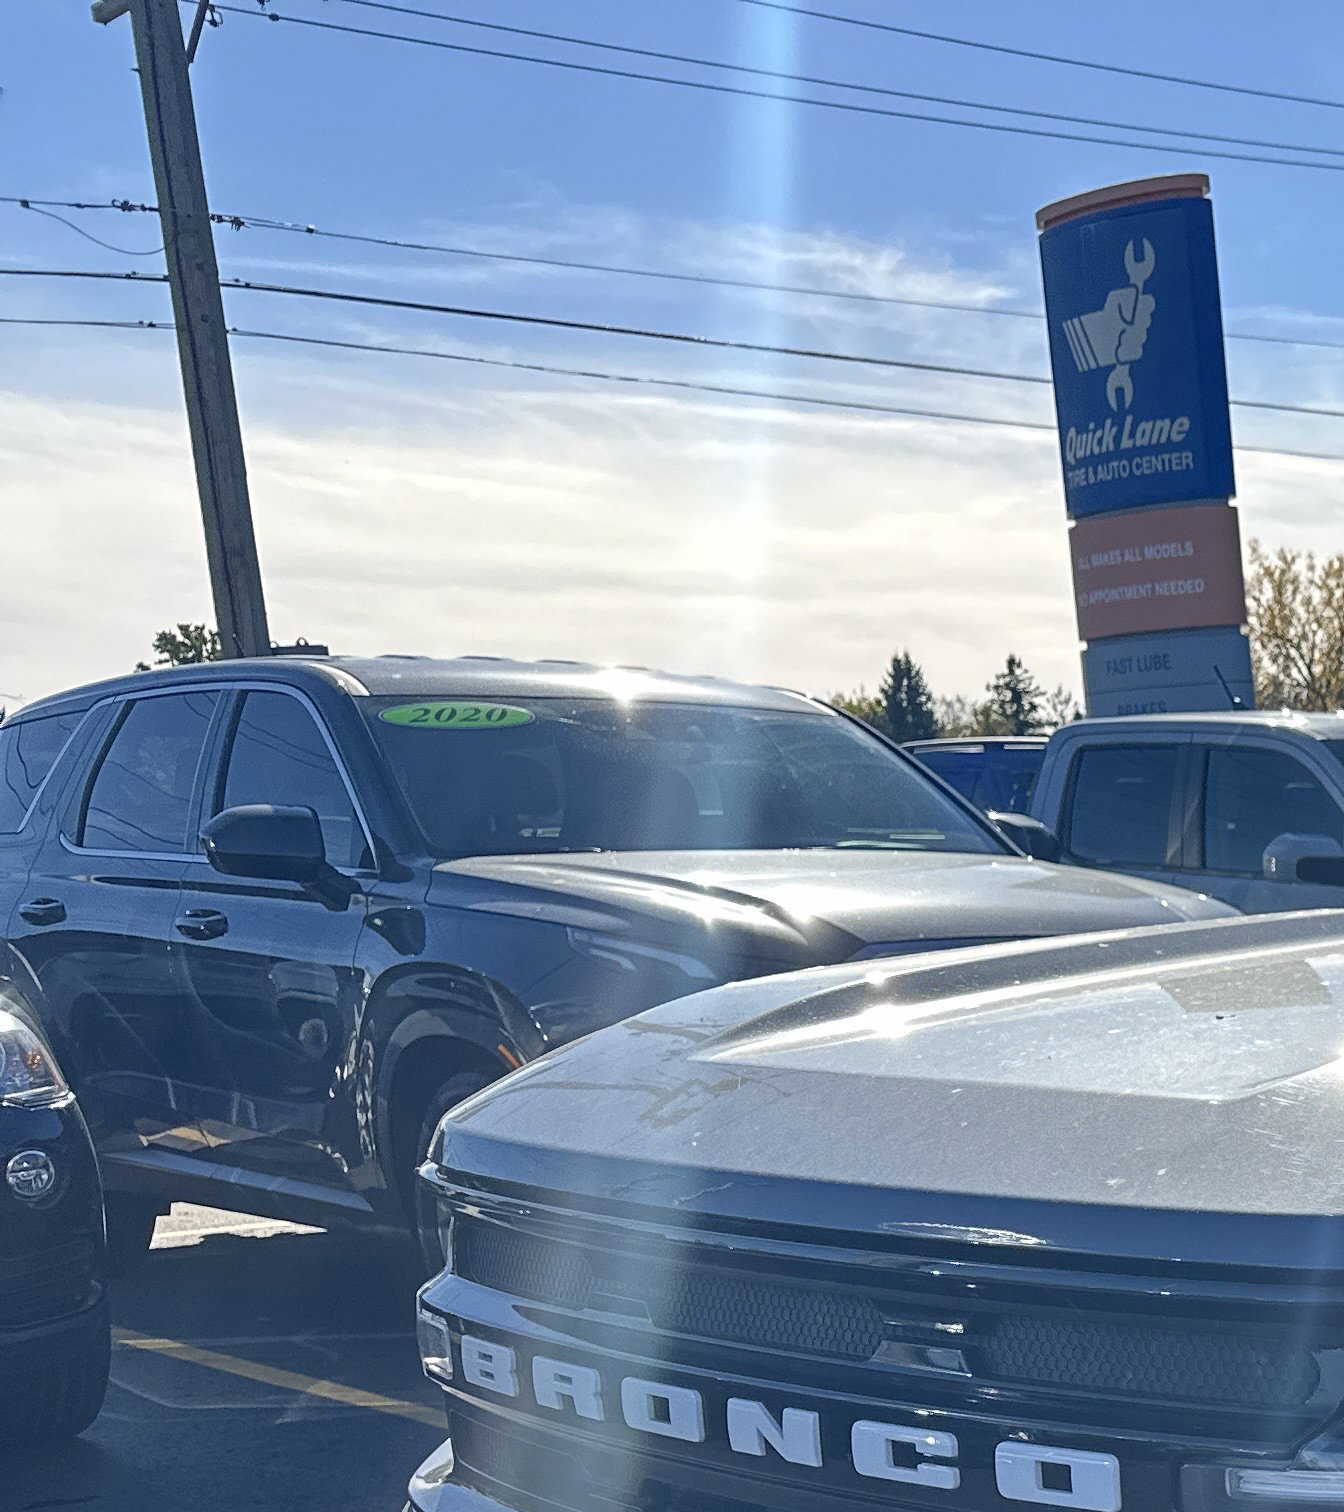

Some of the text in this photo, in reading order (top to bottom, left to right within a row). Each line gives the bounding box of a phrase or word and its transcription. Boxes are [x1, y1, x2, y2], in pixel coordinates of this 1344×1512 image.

[1066, 415, 1191, 465] Quick Lane
[1088, 467, 1096, 484] &
[1096, 460, 1130, 482] AUTO
[1132, 451, 1194, 475] CENTER
[1090, 549, 1121, 567] MAKES
[1122, 547, 1142, 562] ALL
[1143, 540, 1194, 559] MODELS
[1088, 582, 1152, 604] APPOINTMENT
[1154, 578, 1205, 595] NEEDED
[1105, 653, 1172, 675] FAST LUBE
[408, 706, 509, 723] 2020
[460, 1334, 1123, 1512] BRONCO
